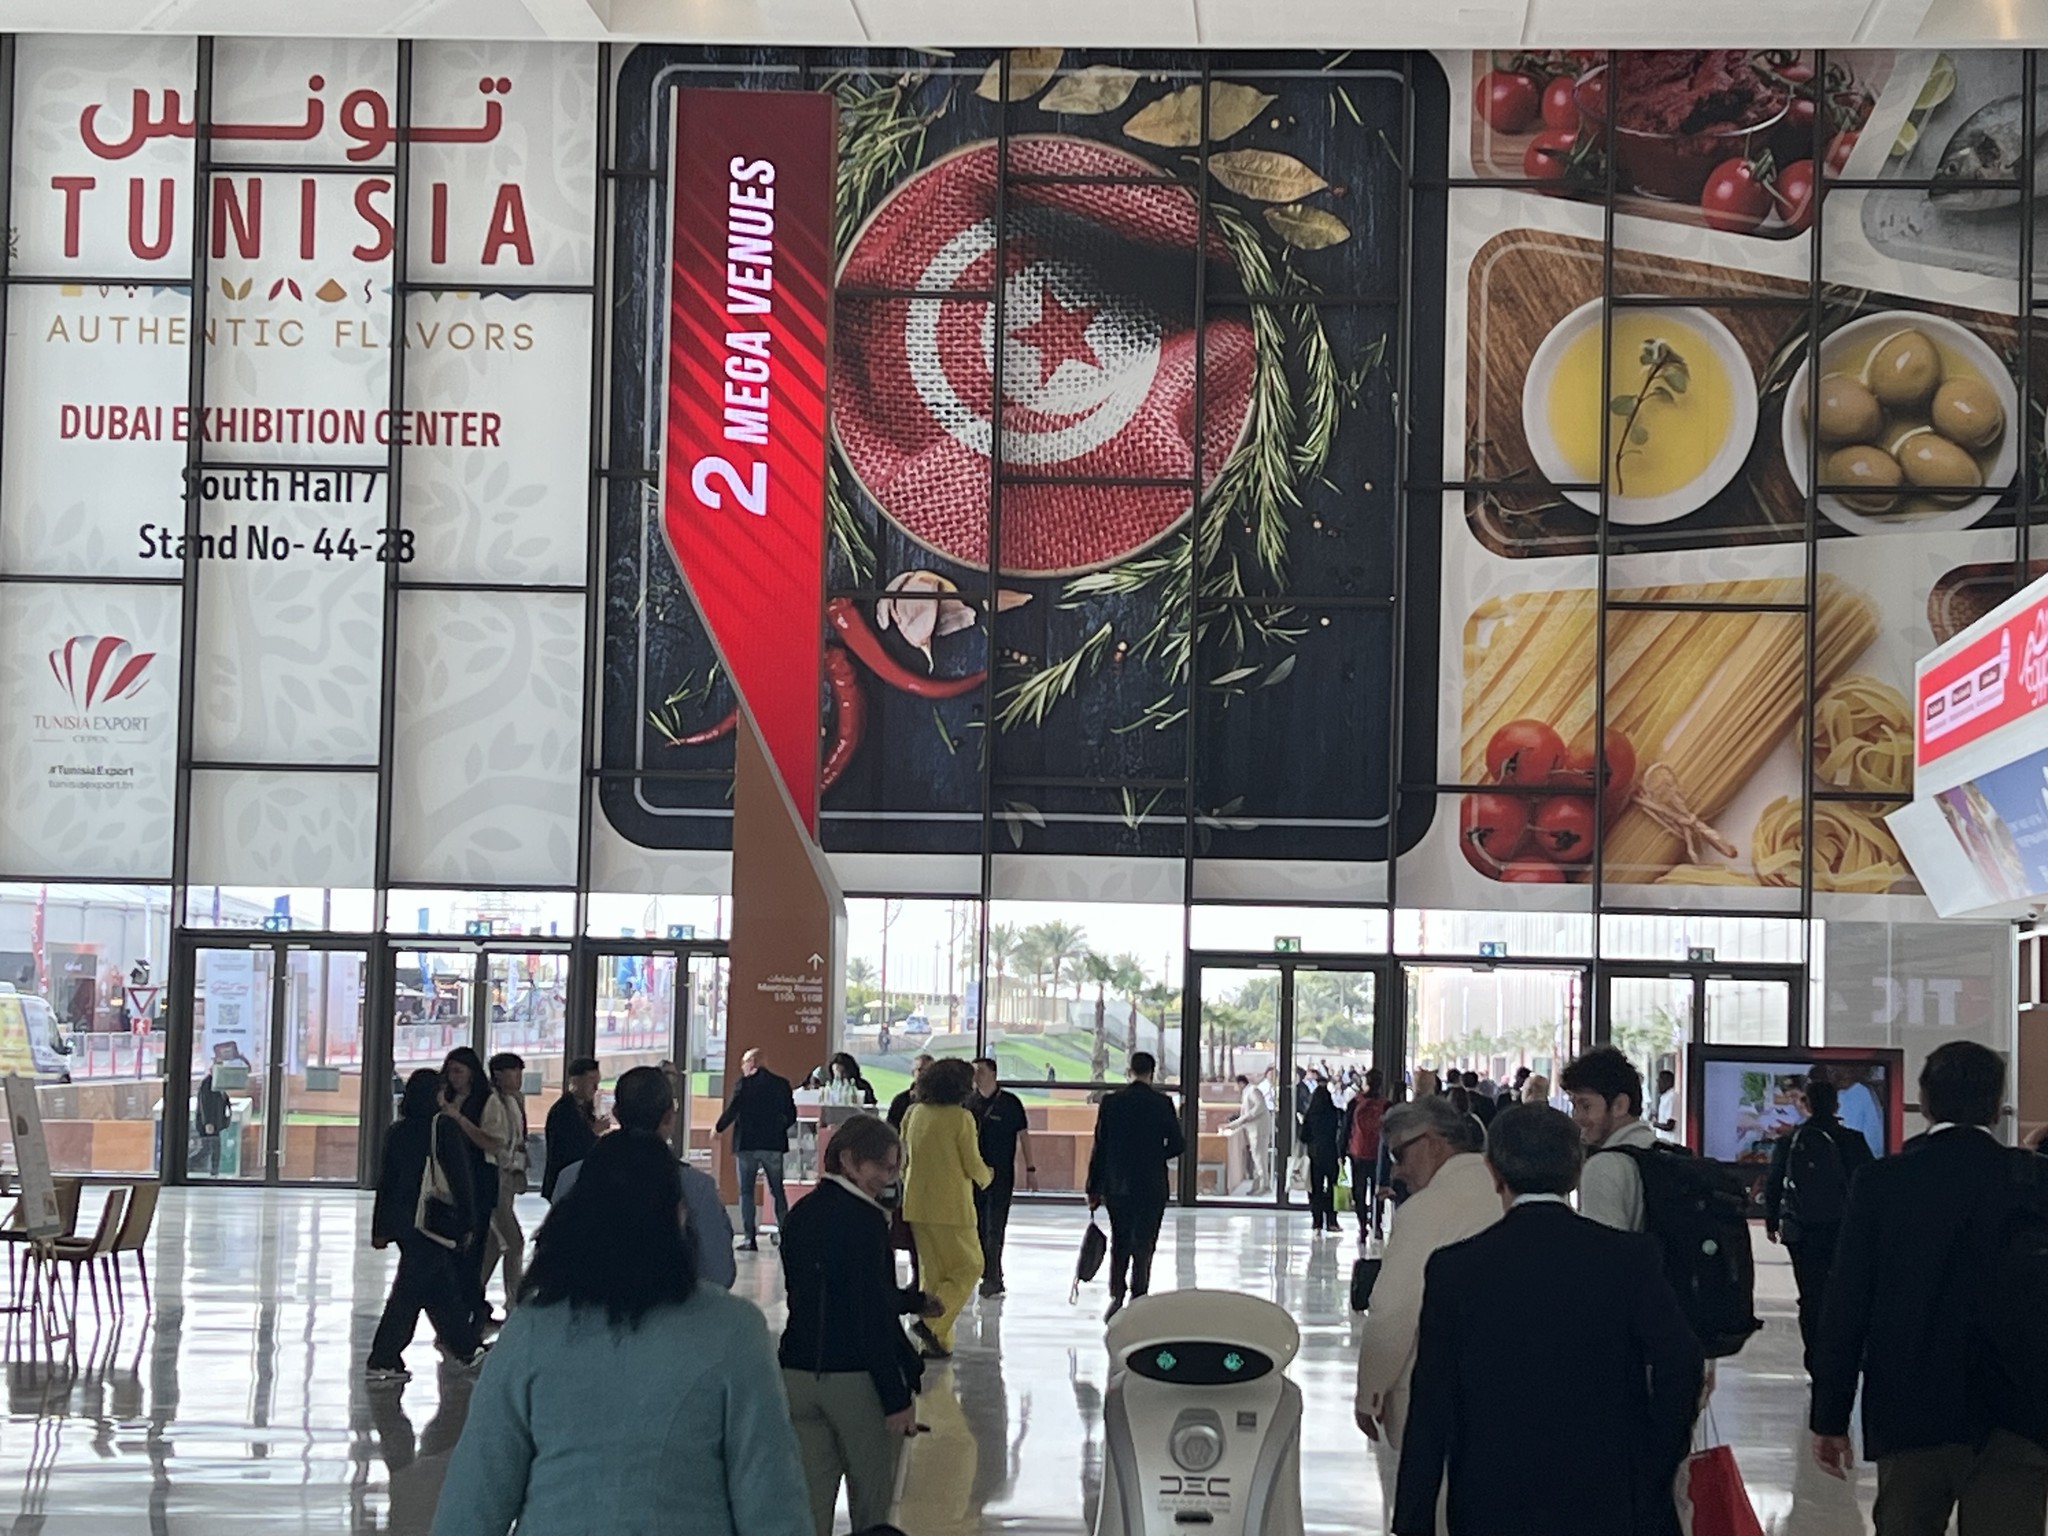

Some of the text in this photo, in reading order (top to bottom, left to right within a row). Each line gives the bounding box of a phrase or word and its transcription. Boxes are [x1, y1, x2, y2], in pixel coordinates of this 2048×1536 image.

[80, 74, 512, 162] تونس
[51, 176, 535, 266] TUNISIA
[46, 314, 305, 346] AUTHENTIC
[691, 156, 776, 517] 2 MEGA VENUES
[60, 404, 502, 448] DUBAI EXHIBITION CENTER
[180, 467, 378, 503] South Hall 7
[138, 523, 238, 560] Stand
[33, 714, 150, 732] TUNISIA EXPORT
[48, 764, 134, 777] #TunisiaExport
